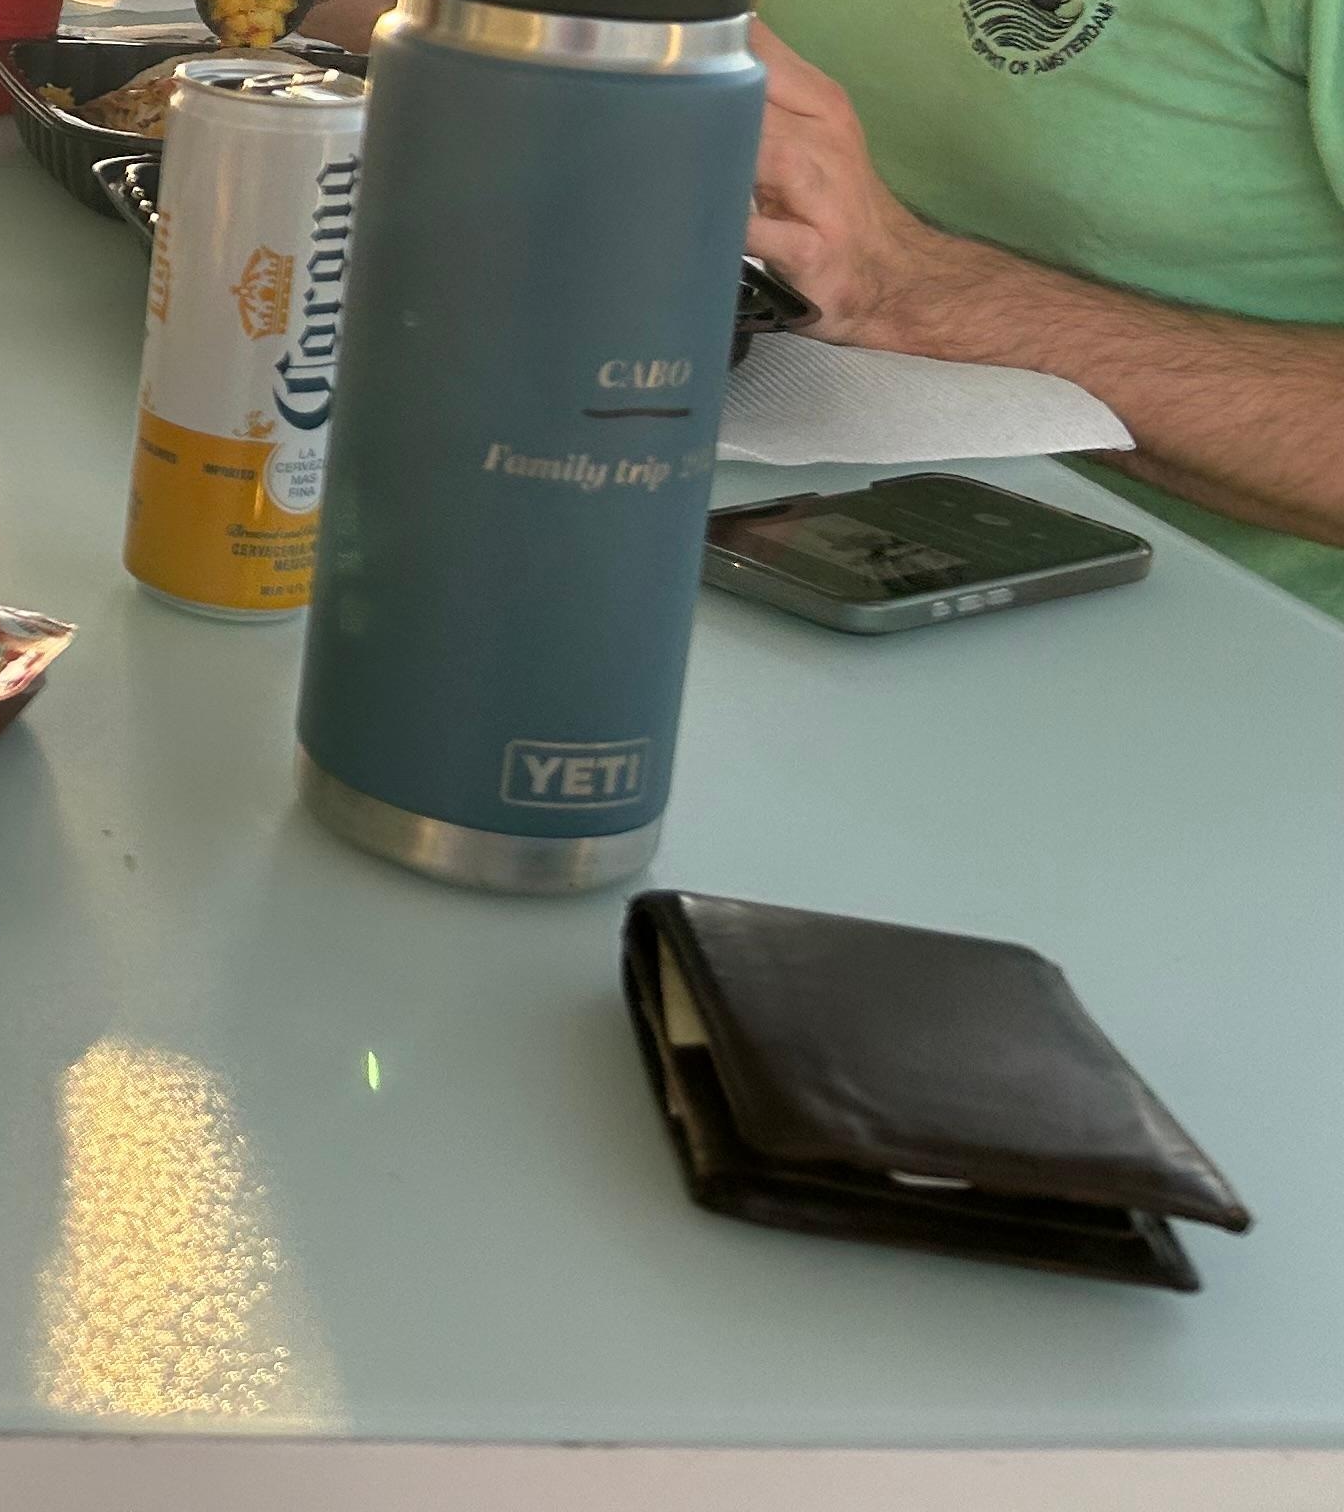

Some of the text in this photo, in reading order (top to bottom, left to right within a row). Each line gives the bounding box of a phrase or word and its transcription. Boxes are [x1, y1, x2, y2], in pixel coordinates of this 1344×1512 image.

[1009, 61, 1029, 76] OF
[1034, 2, 1114, 76] AMSTERDAM
[273, 152, 361, 430] Corona
[596, 360, 693, 389] CABO
[275, 459, 323, 474] CERVEZ
[298, 448, 316, 460] LA
[483, 442, 609, 493] Family
[614, 454, 671, 493] trip
[288, 485, 316, 498] FINA
[290, 473, 317, 486] MAS
[522, 753, 640, 796] YETI
